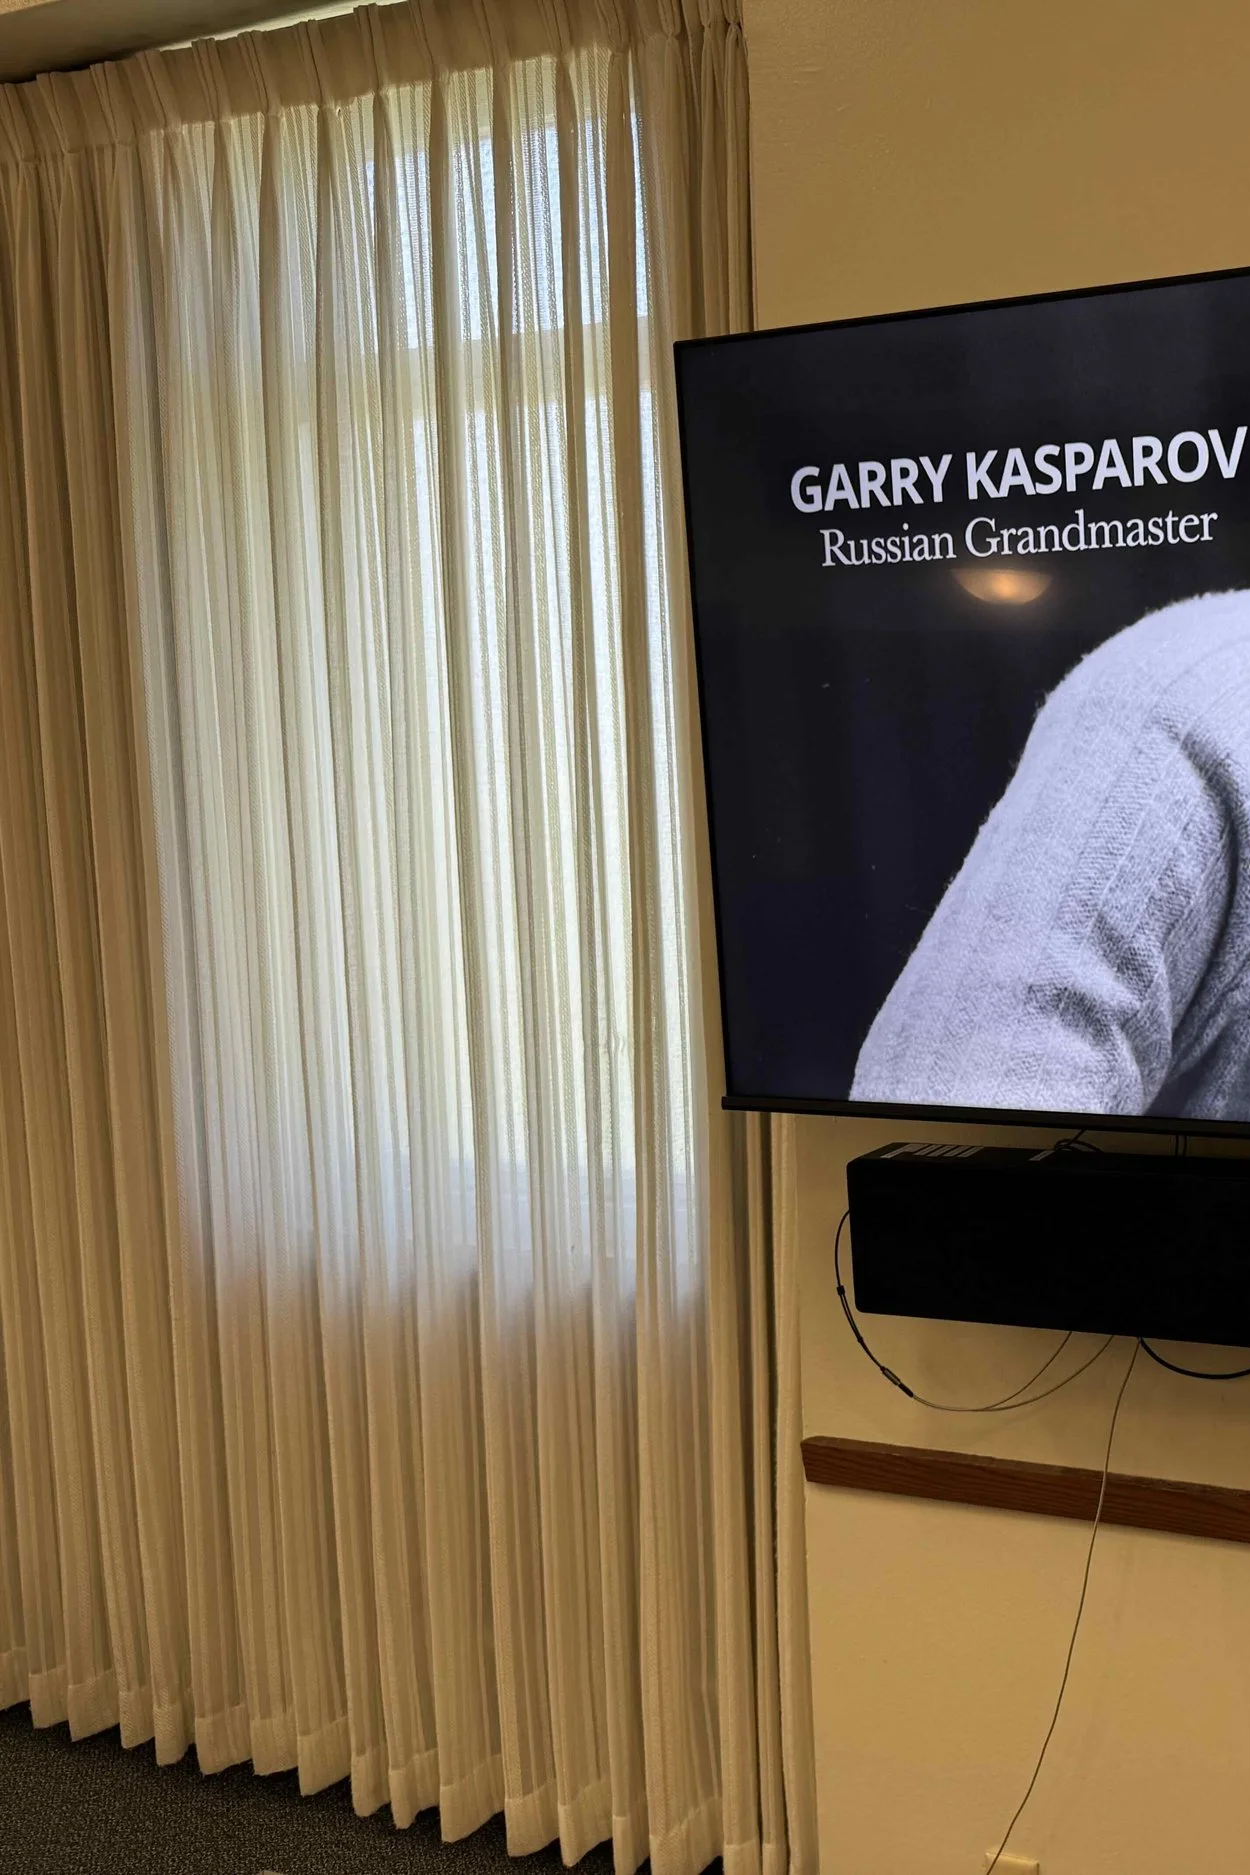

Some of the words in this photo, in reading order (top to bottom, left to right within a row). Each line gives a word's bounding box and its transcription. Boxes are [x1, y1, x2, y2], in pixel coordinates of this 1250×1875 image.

[790, 453, 953, 513] GARRY
[965, 426, 1248, 500] KASPAROV
[819, 522, 957, 567] Russian
[964, 508, 1219, 558] Grandmaster
